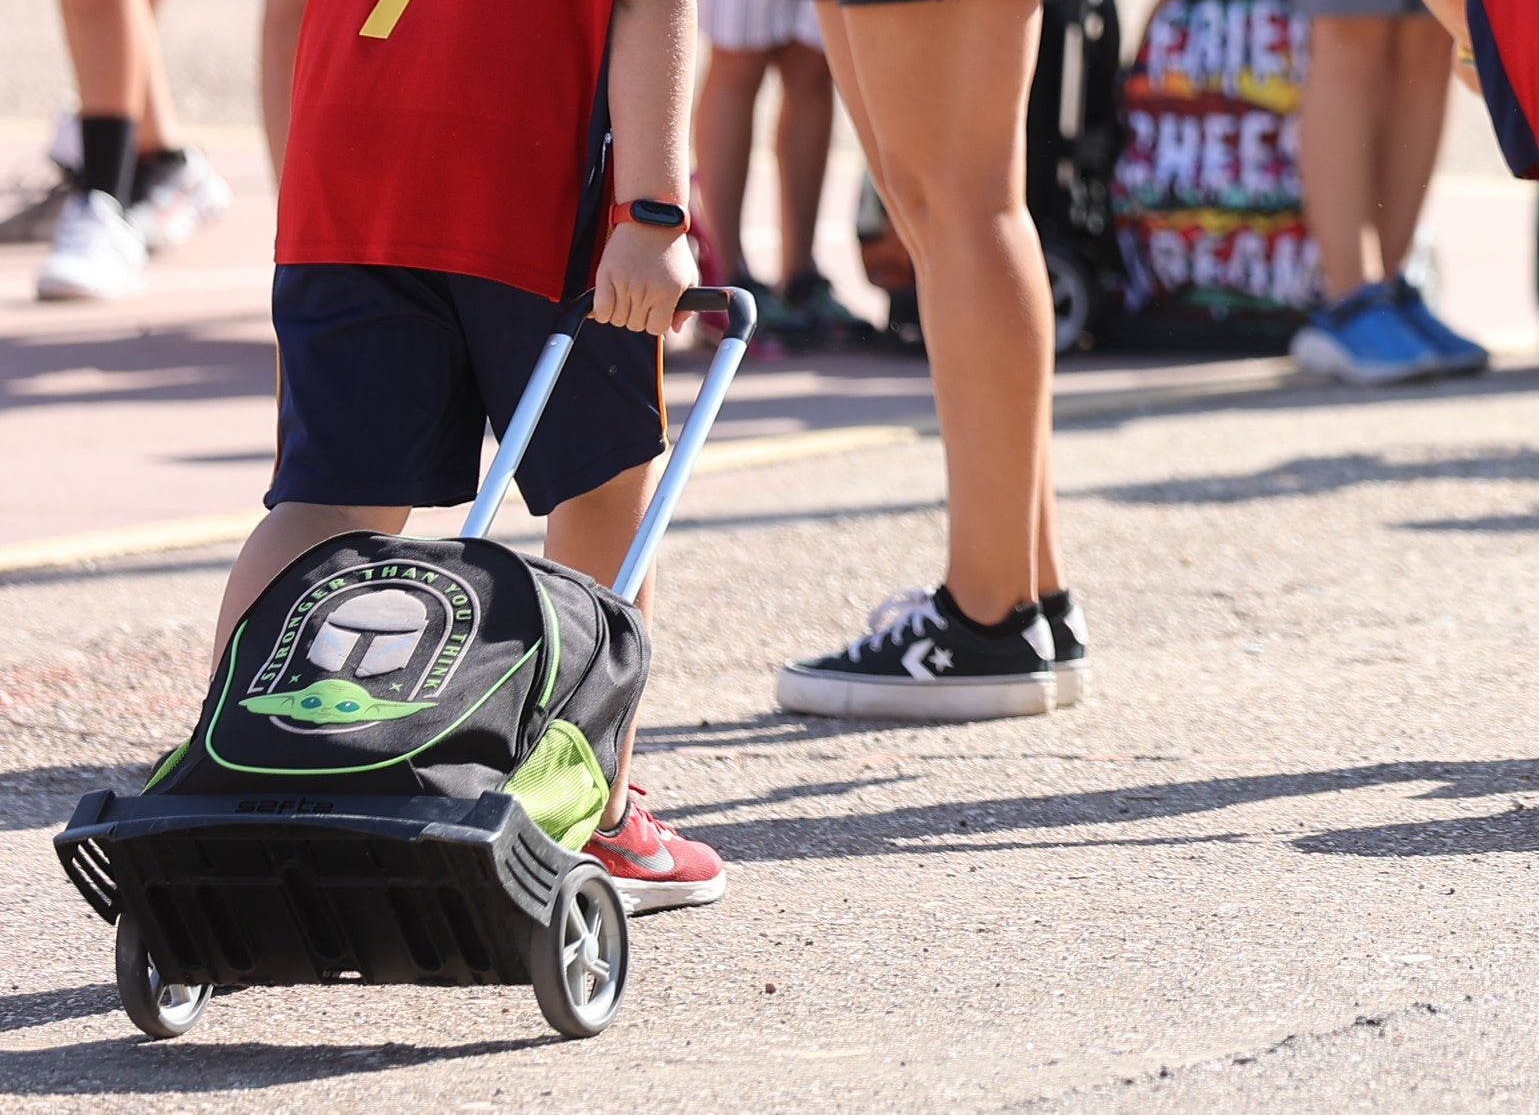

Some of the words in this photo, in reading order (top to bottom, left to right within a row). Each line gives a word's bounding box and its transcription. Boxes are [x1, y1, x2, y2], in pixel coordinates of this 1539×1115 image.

[361, 565, 439, 584] THAN
[443, 582, 473, 622] YOU
[260, 577, 348, 682] STRONGER
[423, 632, 469, 689] THINK
